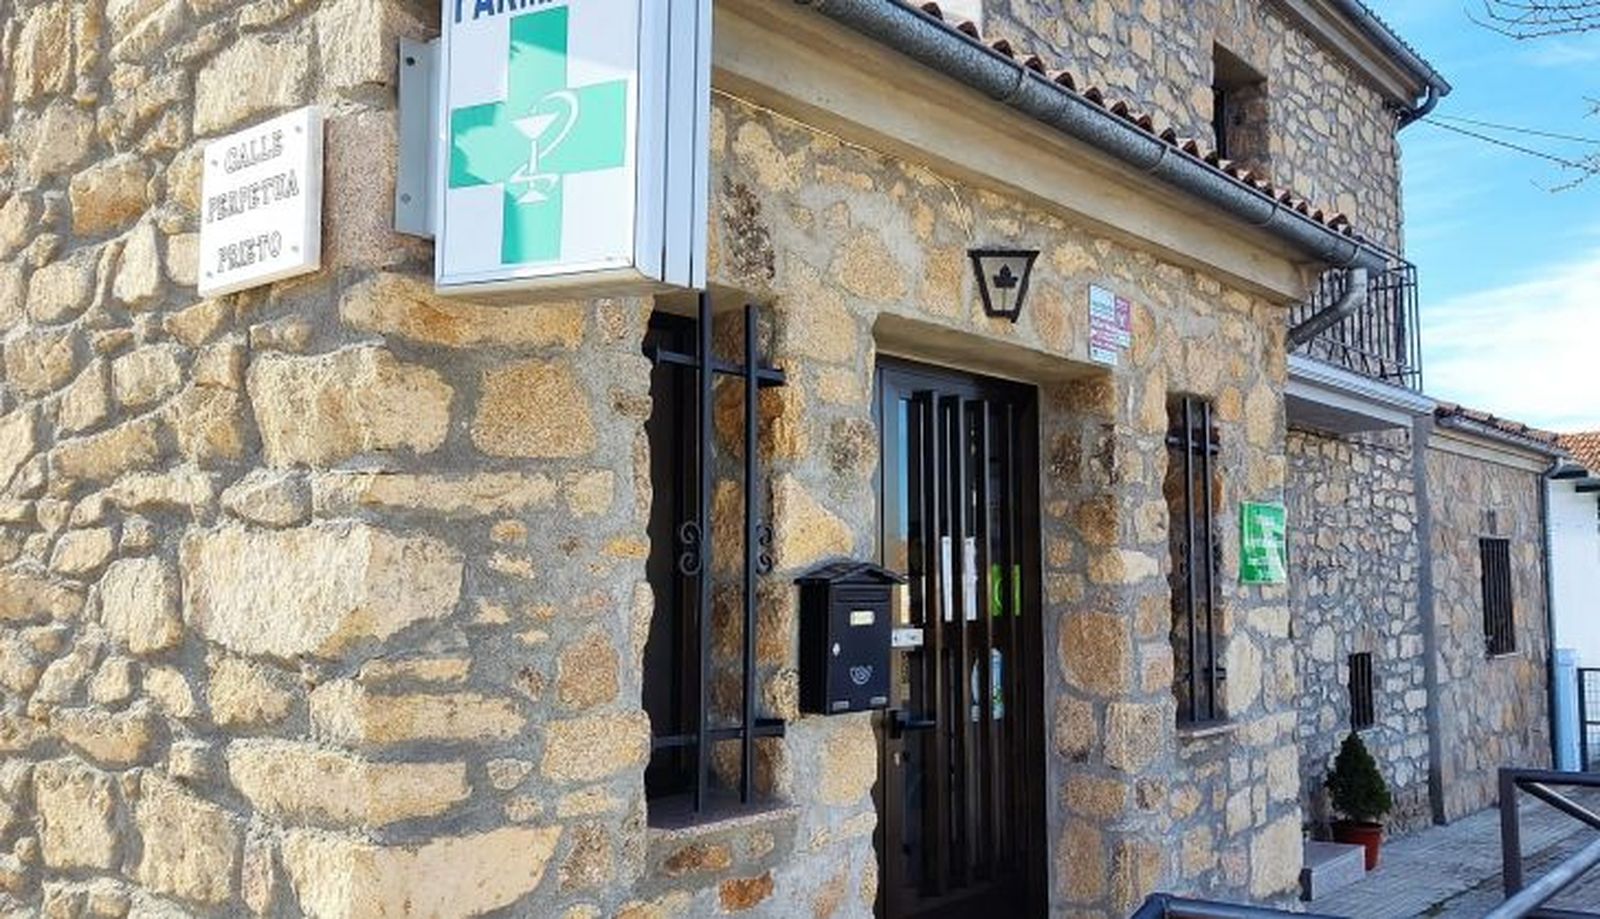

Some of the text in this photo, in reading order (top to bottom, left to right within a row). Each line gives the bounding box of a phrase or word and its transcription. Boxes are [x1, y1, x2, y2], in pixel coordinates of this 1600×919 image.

[224, 129, 283, 174] CALLE
[207, 168, 299, 223] PERPETUA
[217, 230, 282, 274] PRIETO
